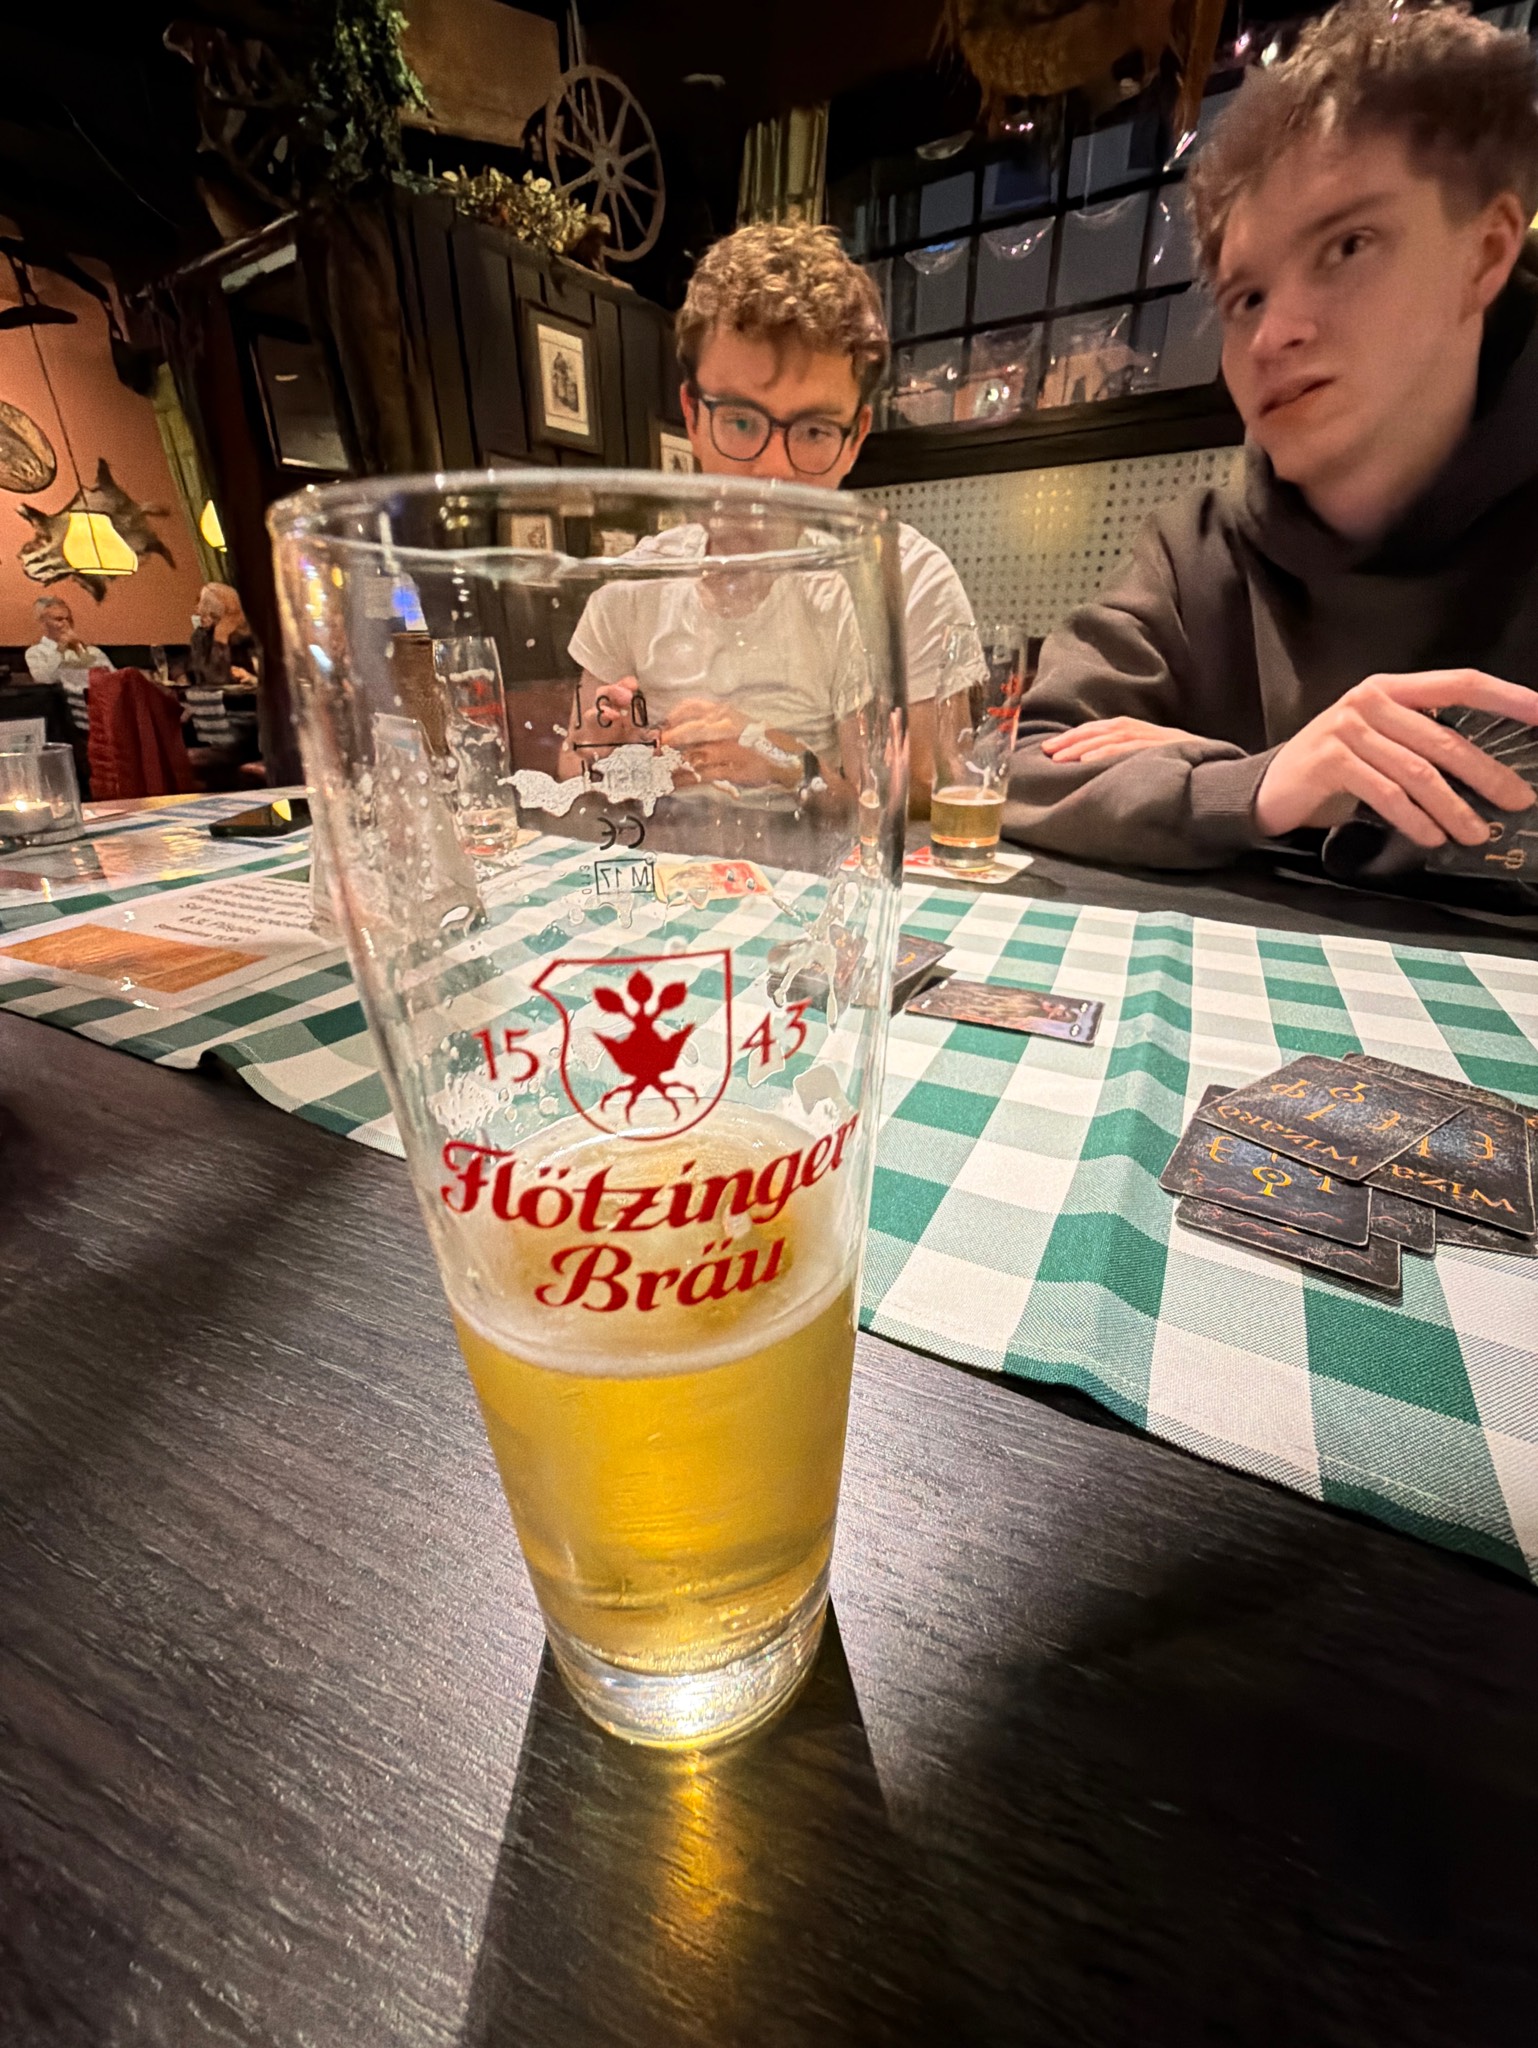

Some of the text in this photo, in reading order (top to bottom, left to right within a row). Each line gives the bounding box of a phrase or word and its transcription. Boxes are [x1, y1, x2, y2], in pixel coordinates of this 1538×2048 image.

[472, 998, 813, 1083] 15 43
[440, 1113, 859, 1233] Flötzinger
[534, 1237, 785, 1313] Bräu
